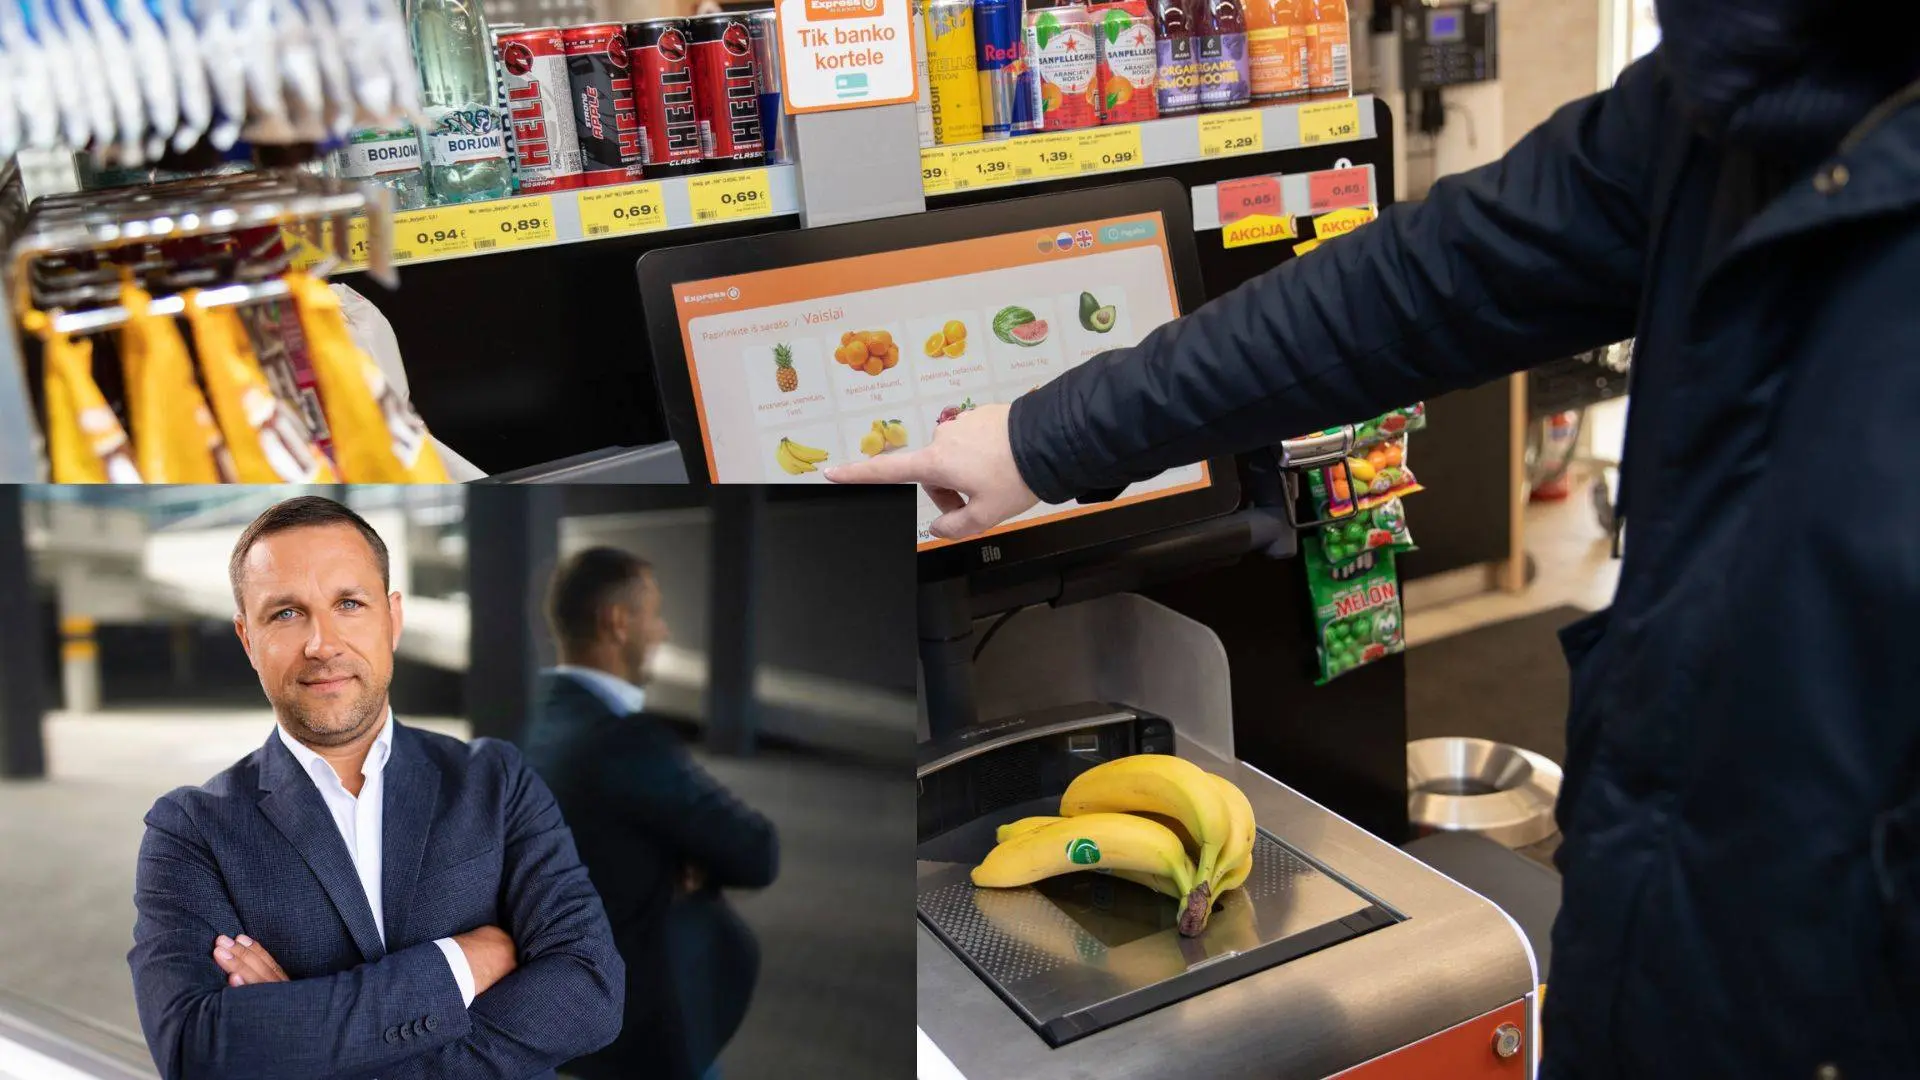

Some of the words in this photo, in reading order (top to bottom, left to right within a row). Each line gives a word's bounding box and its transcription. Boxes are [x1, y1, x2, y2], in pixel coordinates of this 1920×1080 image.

[797, 28, 829, 47] Tik
[835, 24, 895, 44] banko
[815, 48, 884, 70] kortele
[985, 41, 1017, 61] Red
[929, 72, 959, 81] DITION
[581, 93, 591, 128] STRONG
[660, 66, 701, 151] HELL
[725, 61, 761, 144] HELL
[586, 86, 603, 140] APPLE
[508, 80, 551, 168] HELL
[1328, 124, 1351, 137] 1,19
[1224, 137, 1253, 150] 2,29
[1039, 151, 1068, 164] 1,39
[1102, 152, 1132, 165] 0,99
[922, 168, 942, 179] 39
[976, 161, 1005, 175] 1,39
[721, 190, 757, 205] 0,69
[613, 204, 652, 220] 0,69
[500, 218, 541, 234] 0,89
[1229, 223, 1285, 243] AKCIJA
[416, 228, 458, 245] 0,94
[1334, 582, 1395, 618] MELON
